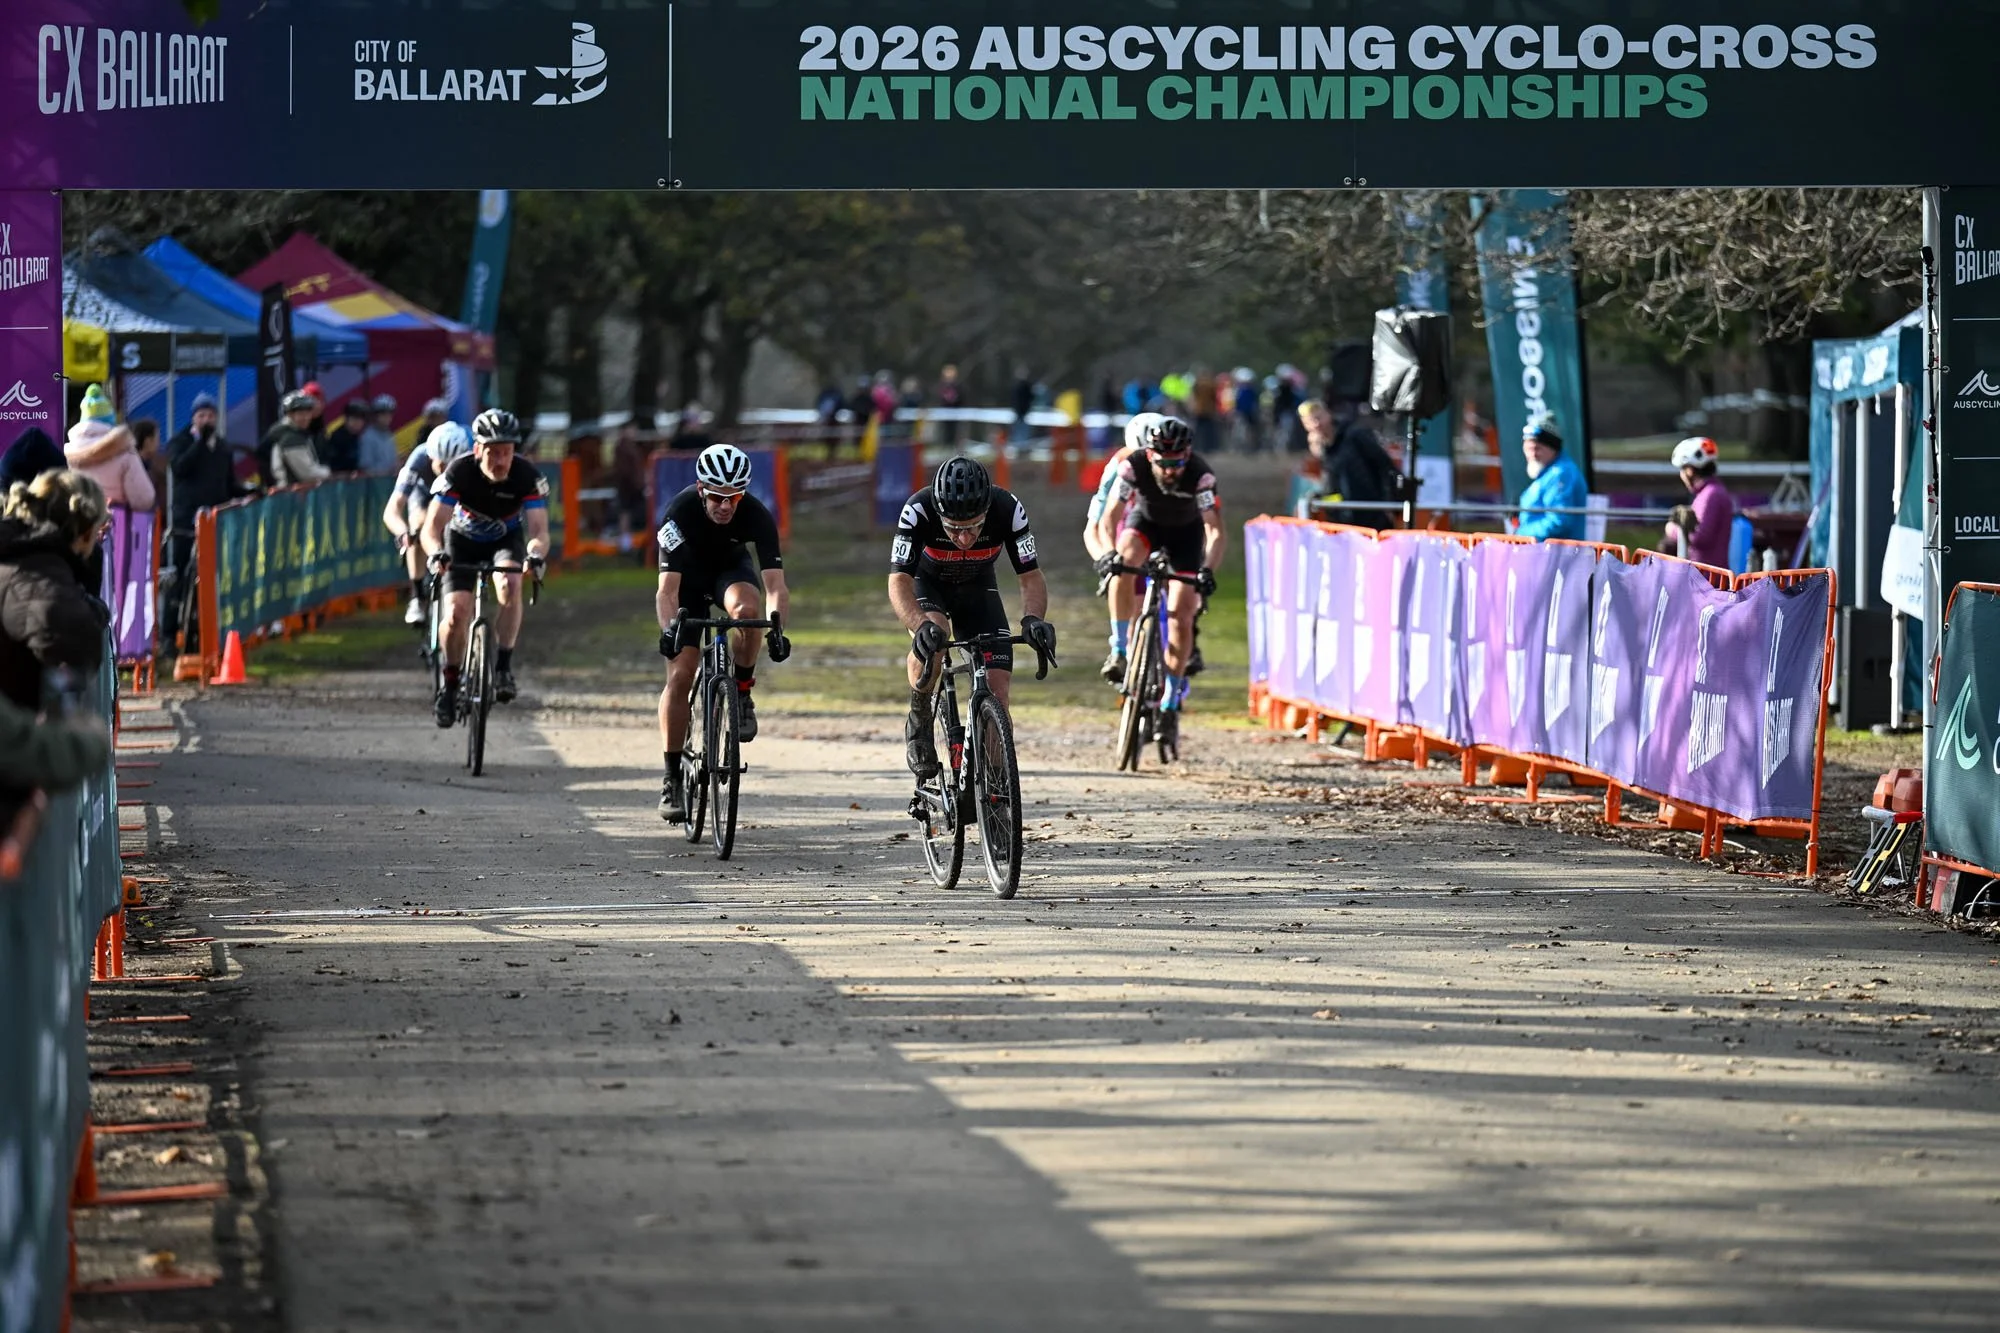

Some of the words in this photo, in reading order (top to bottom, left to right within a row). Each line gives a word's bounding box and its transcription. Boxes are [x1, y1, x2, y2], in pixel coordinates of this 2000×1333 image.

[354, 40, 391, 63] CITY
[397, 40, 417, 63] OF
[799, 25, 959, 71] 2026
[970, 25, 1395, 71] AUSCYCLING
[1408, 24, 1877, 70] CYCLO-CROSS
[38, 24, 85, 115] CX
[97, 27, 227, 111] BALLARAT
[354, 69, 526, 102] BALLARAT
[799, 75, 1137, 120] NATIONAL
[1146, 74, 1709, 120] CHAMPIONSHIPS
[0, 222, 11, 256] X
[1955, 214, 1975, 249] CX
[663, 527, 678, 547] 164
[1955, 516, 2000, 533] LOCAL
